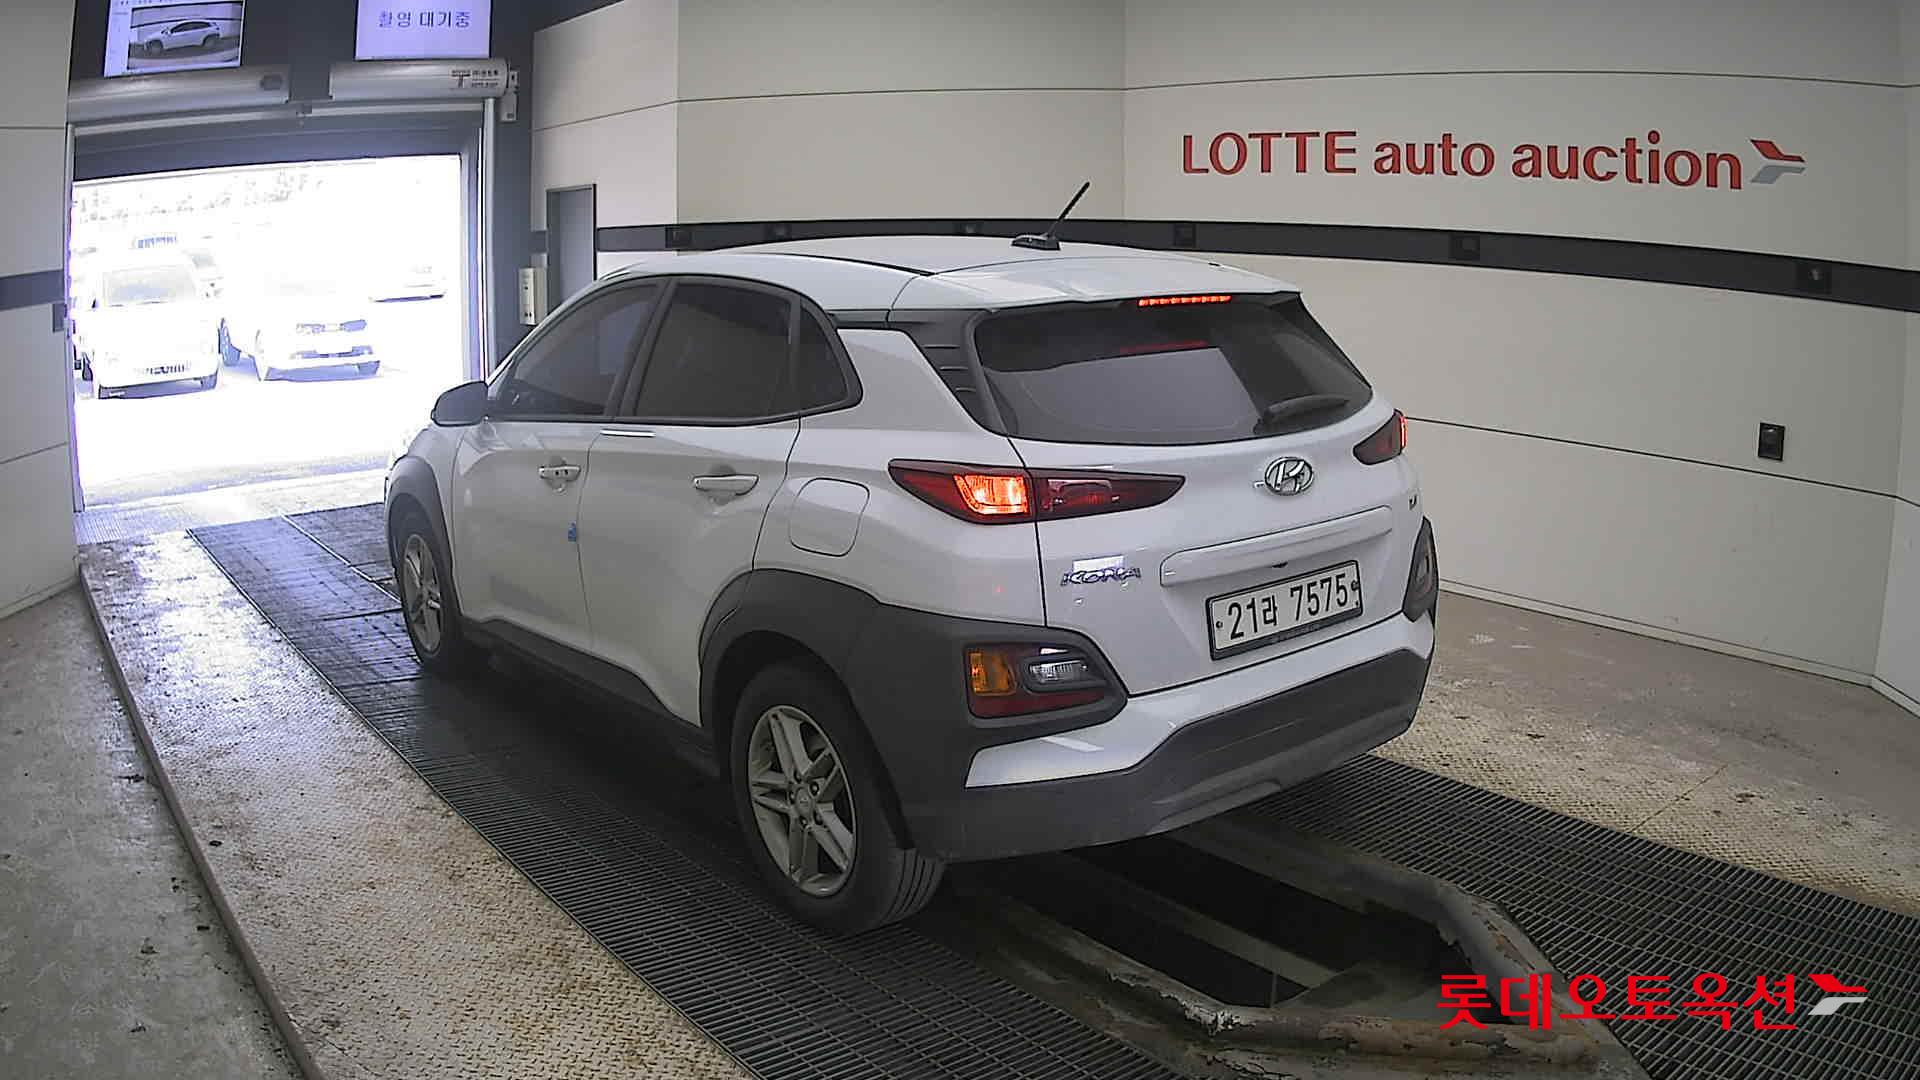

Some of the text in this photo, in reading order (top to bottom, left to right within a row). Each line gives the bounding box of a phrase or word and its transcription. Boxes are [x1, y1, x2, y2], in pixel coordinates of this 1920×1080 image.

[419, 10, 472, 28] 대기중
[1183, 130, 1742, 190] LOTTE auto auction
[1228, 573, 1348, 640] 21라 7575
